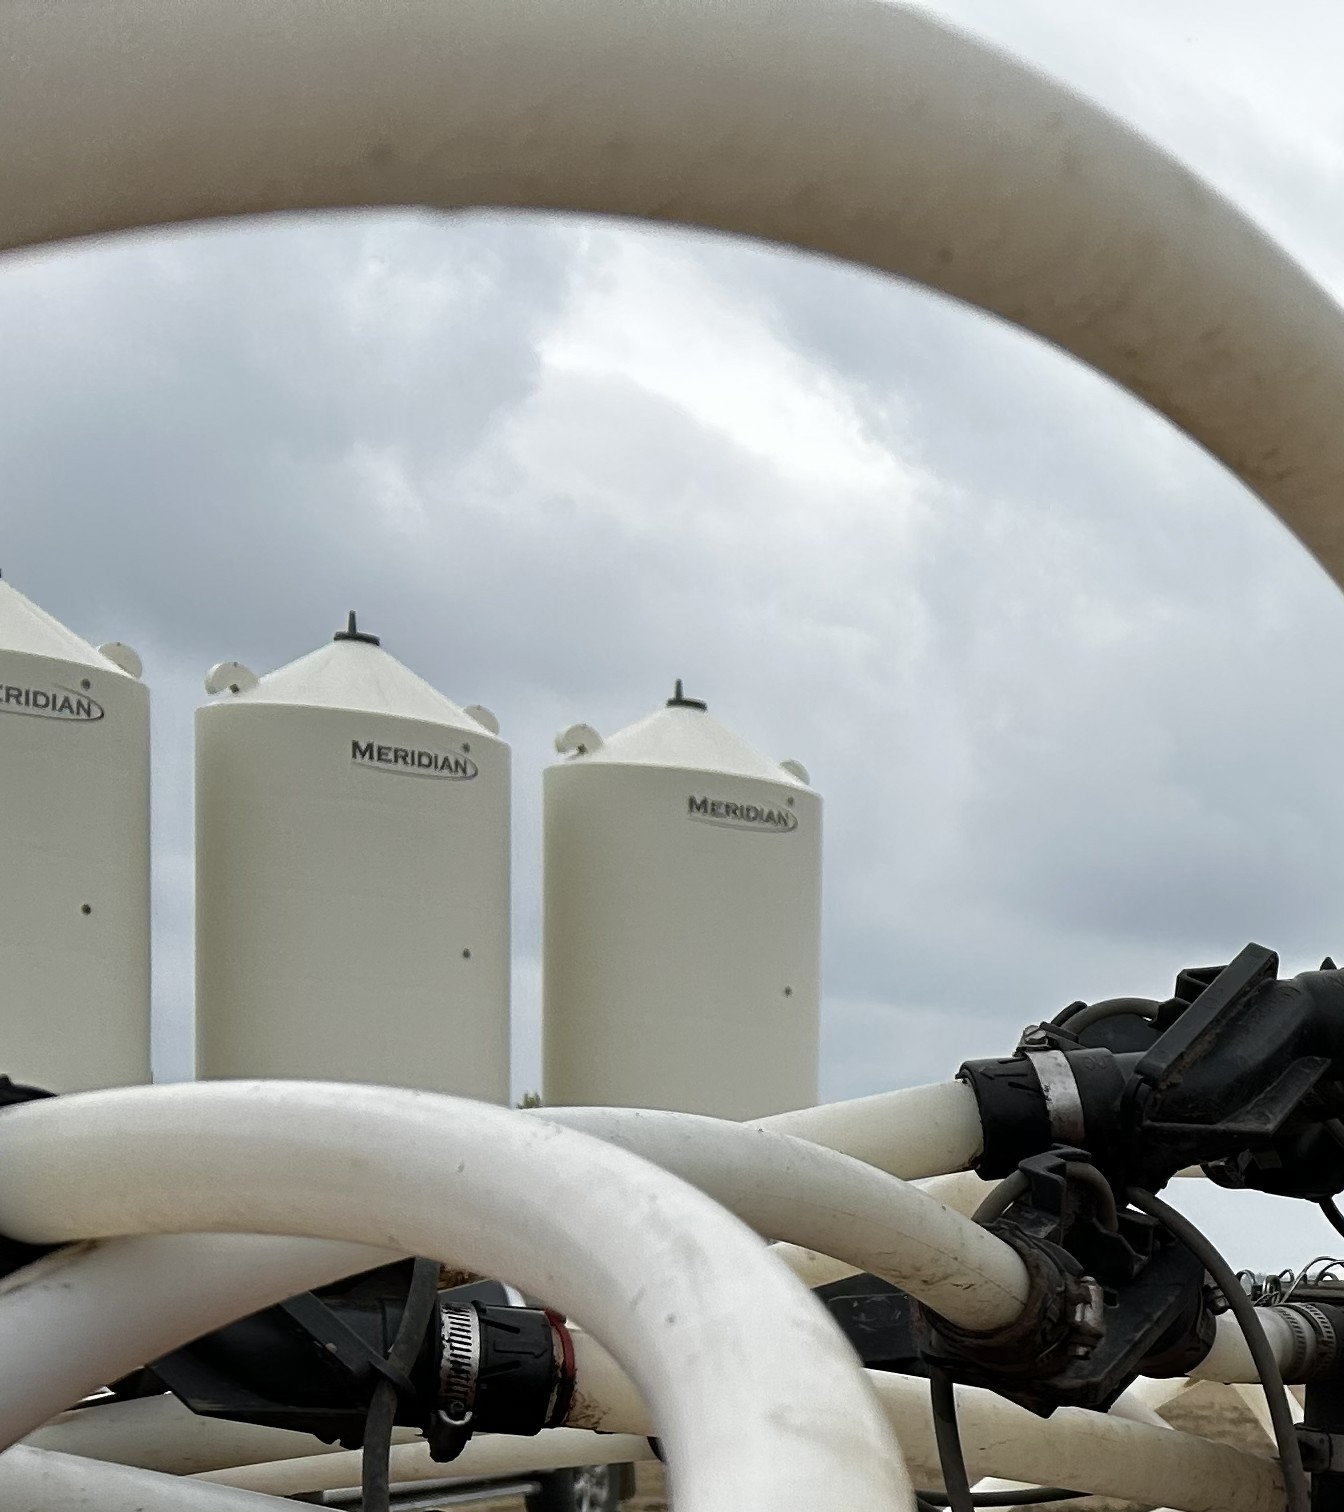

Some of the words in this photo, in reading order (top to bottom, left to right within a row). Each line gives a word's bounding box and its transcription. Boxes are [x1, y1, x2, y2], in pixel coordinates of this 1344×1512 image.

[0, 684, 91, 718] RIDIAN
[351, 739, 468, 776] MERIDIAN
[688, 795, 789, 827] MERIDIAN
